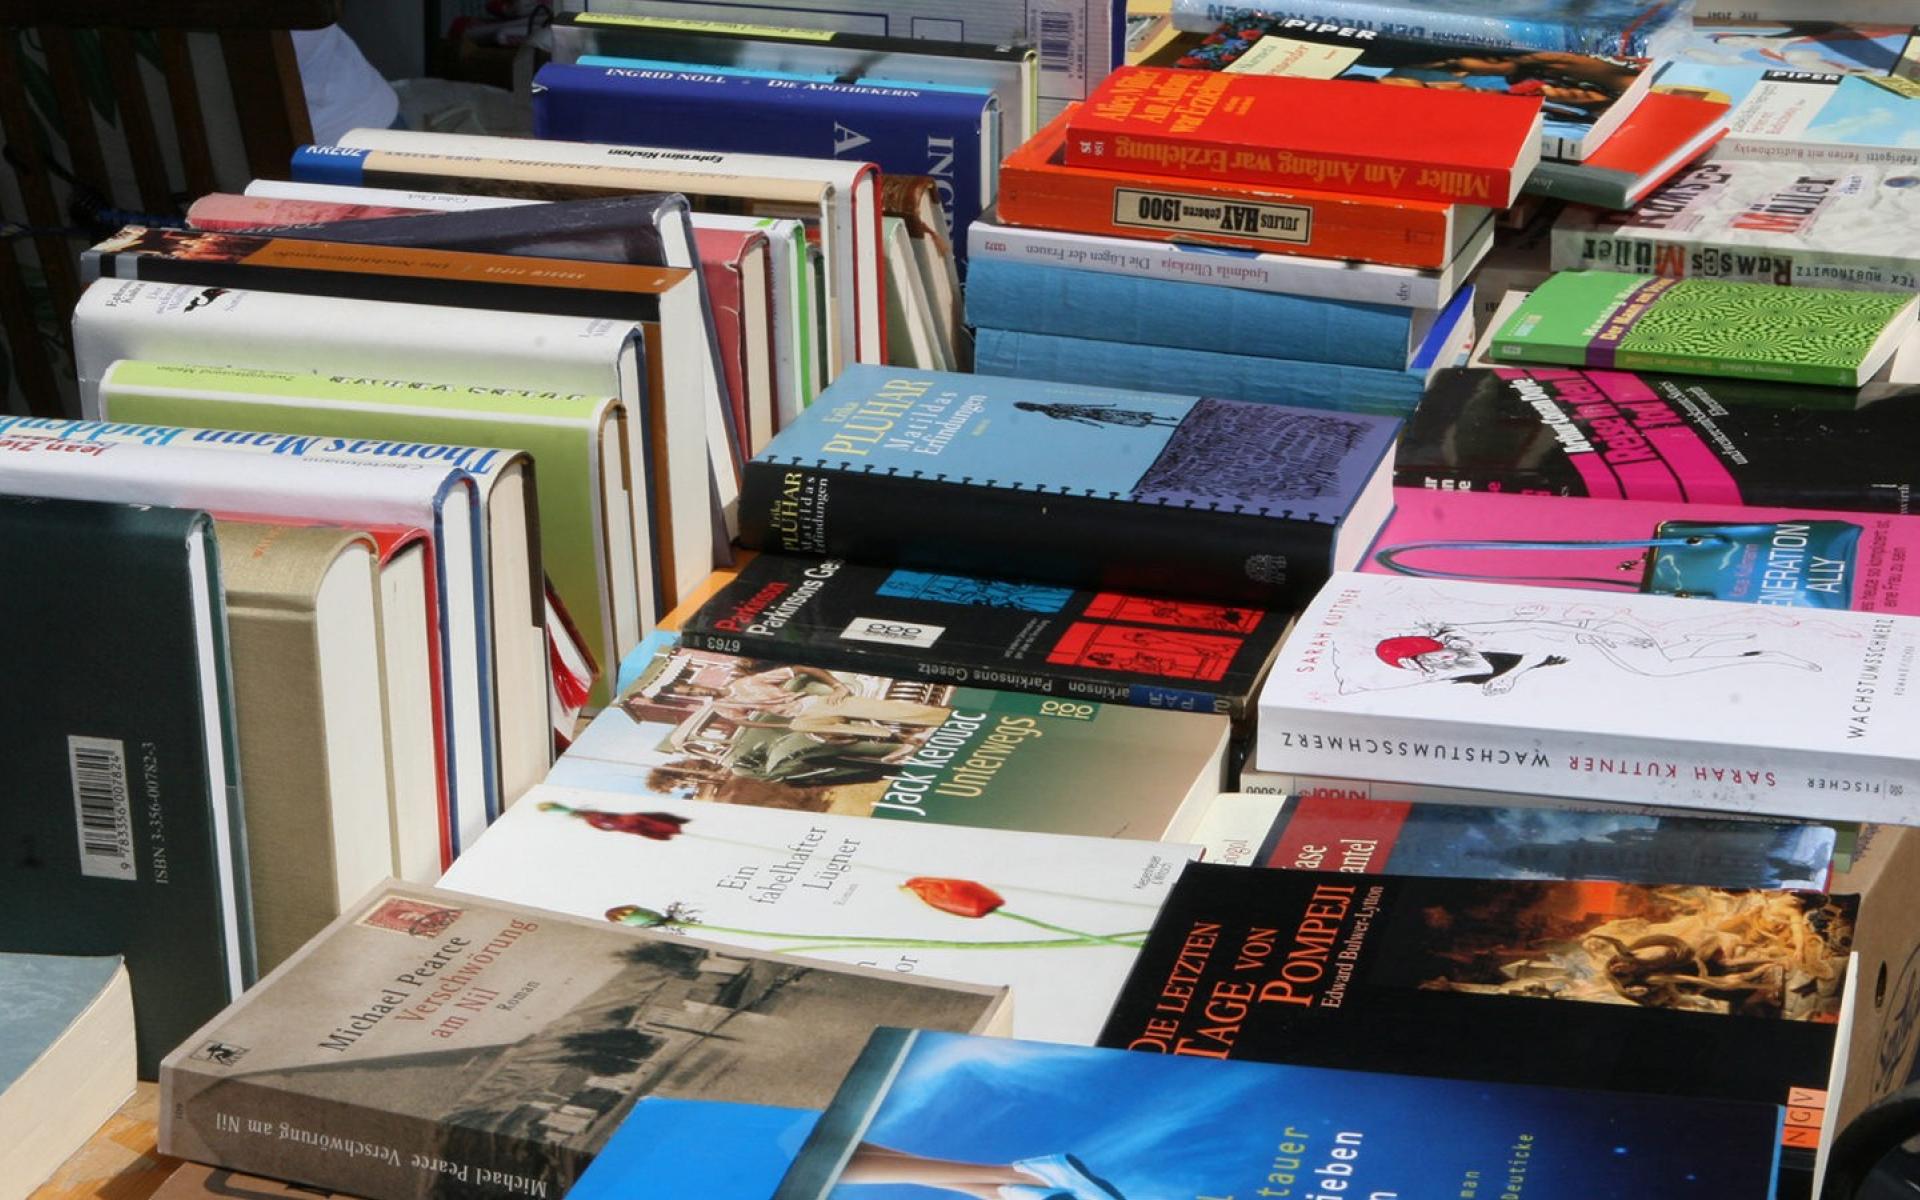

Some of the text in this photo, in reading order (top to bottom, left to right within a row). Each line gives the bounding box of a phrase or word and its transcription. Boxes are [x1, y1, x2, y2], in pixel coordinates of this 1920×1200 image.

[1281, 18, 1378, 41] PIPER
[605, 68, 673, 81] INGRID
[677, 73, 726, 84] NOLL
[1770, 71, 1840, 81] PIPER
[305, 145, 363, 157] KREUZ
[608, 148, 725, 163] Ephraim Kishon
[1115, 135, 1492, 198] Miller Am Anfang war Erziehung
[1807, 148, 1825, 159] mit
[1827, 149, 1860, 162] Ferien
[1138, 196, 1182, 222] 1900
[1220, 205, 1259, 233] HAY
[1260, 214, 1300, 232] JULIUS
[1731, 176, 1842, 233] Müller
[1026, 244, 1065, 260] Frauen
[1068, 250, 1088, 263] der
[1090, 251, 1126, 268] Lügen
[1129, 256, 1150, 270] Die
[1582, 238, 1687, 277] Müller
[1217, 265, 1269, 283] Ljudmila
[1796, 266, 1882, 282] RUBINOWITZ
[1891, 274, 1916, 289] TEX
[1598, 325, 1624, 340] Der
[821, 378, 935, 457] PLUHAR
[883, 392, 958, 452] Matildas
[913, 394, 988, 456] Erfindungen
[44, 442, 104, 456] Jean
[193, 429, 321, 456] Mann
[324, 439, 499, 475] Thomas
[781, 472, 802, 551] PLUHAR
[801, 476, 816, 553] Matildas
[814, 477, 830, 554] Erfindungen
[1756, 523, 1811, 607] ENERATION
[1805, 555, 1846, 593] ALLY
[715, 580, 790, 633] Parkinson
[746, 579, 824, 636] Parkinsons
[707, 636, 741, 652] 6763
[1296, 589, 1361, 672] SARAH KUTTNER
[918, 662, 1130, 698] arkinson Parkinsons Gesetz
[1846, 619, 1896, 740] WACHSTUMSSCHMERZ
[871, 710, 987, 816] Jack Kerouac
[935, 715, 1043, 798] Unterwegs
[1281, 731, 1881, 794] FISCHER SARAH KUTTNER WACHSTUMSSCHMERZ
[141, 741, 169, 884] ISBN 3-356-00782-3
[749, 826, 827, 904] fabelhafter
[802, 838, 861, 891] Lügner
[1294, 844, 1327, 869] ase
[1339, 839, 1378, 873] antel
[716, 865, 759, 891] Ein
[1257, 884, 1357, 1008] POMPEJI
[1320, 885, 1385, 1009] Edward Bulwer-Lytton
[393, 918, 538, 1024] Verschwörung
[1156, 921, 1224, 1014] LETZTEN
[317, 934, 472, 1052] Michael Pearce
[496, 980, 541, 1012] Roman
[1173, 926, 1280, 1060] TAGE VON
[431, 987, 499, 1039] am Nil
[215, 1112, 241, 1133] Nil
[248, 1119, 273, 1136] am
[279, 1121, 401, 1167] Verschwörung
[1257, 1126, 1310, 1197] tauer
[411, 1154, 469, 1183] Pearce
[476, 1167, 548, 1198] Michael
[1306, 1130, 1364, 1200] ieben
